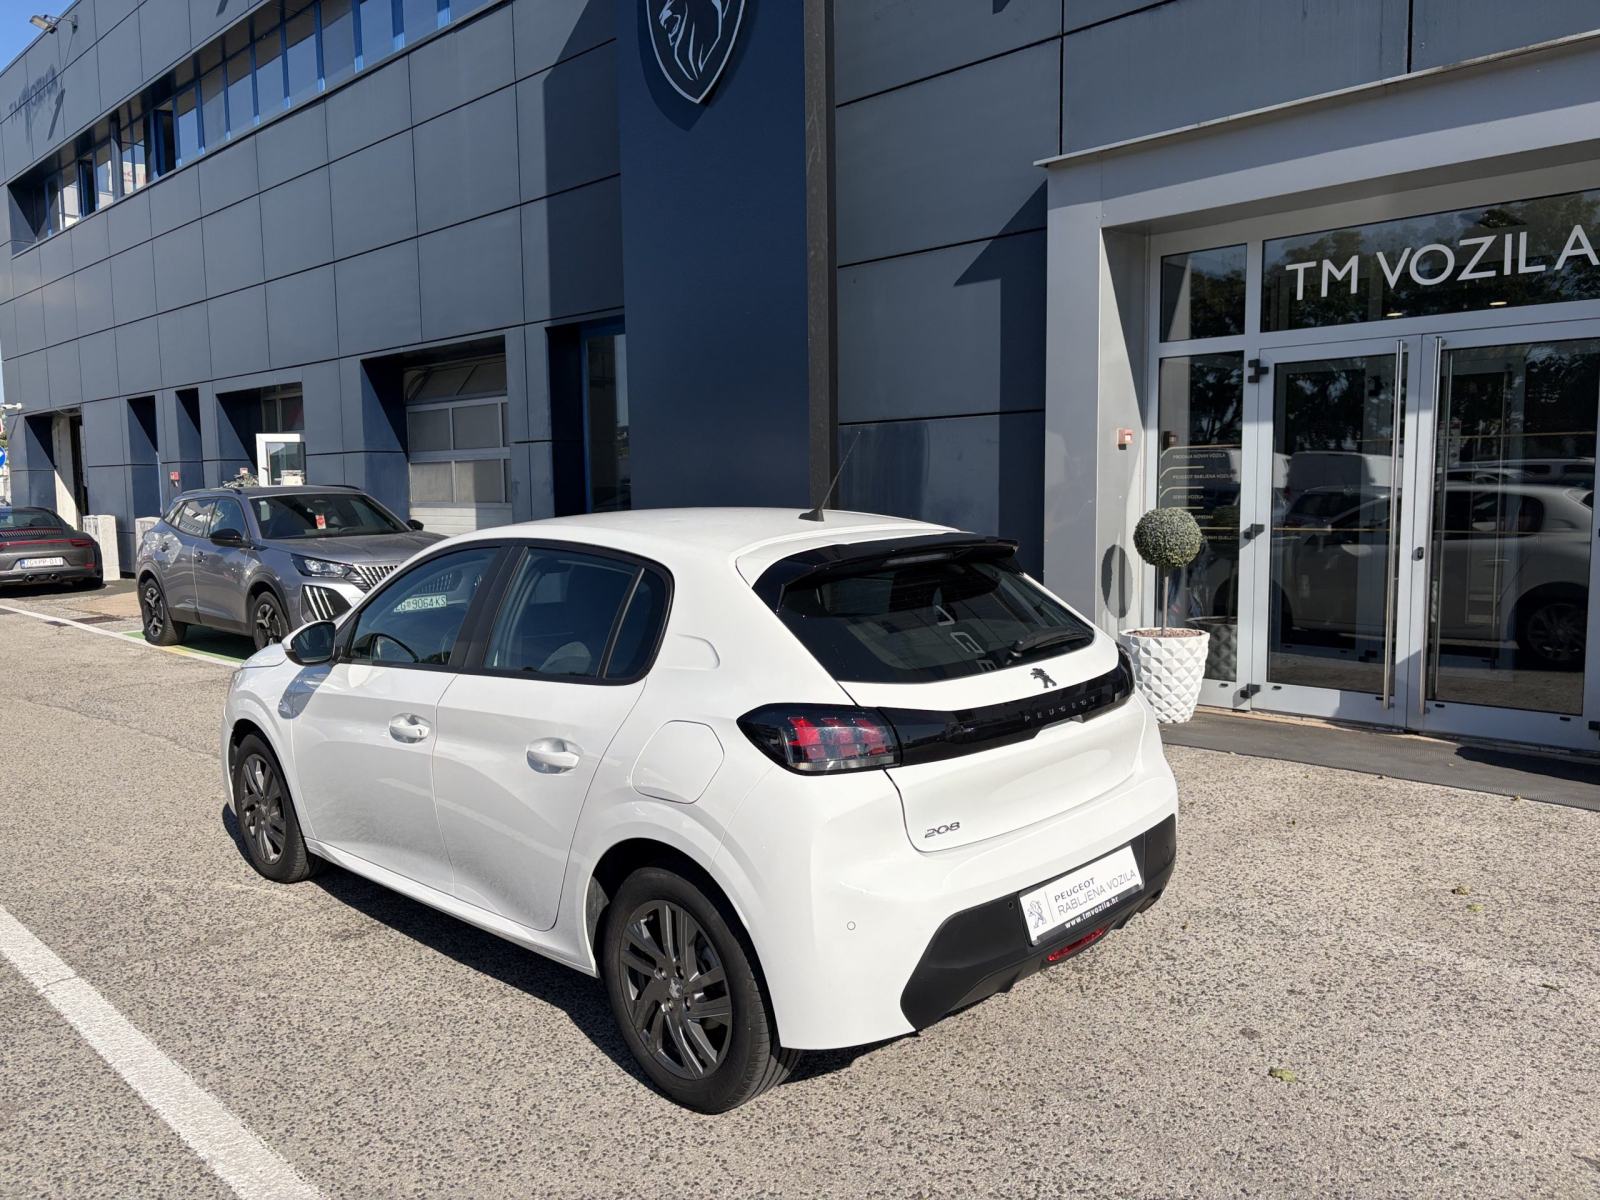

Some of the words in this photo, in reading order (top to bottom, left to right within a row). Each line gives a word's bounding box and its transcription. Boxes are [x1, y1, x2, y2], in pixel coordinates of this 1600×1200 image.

[1285, 255, 1360, 301] TM
[1376, 224, 1600, 290] VOZILA
[1024, 695, 1096, 722] PEUGEOT
[925, 821, 960, 838] 208
[1054, 877, 1096, 903] PEUGEOT
[1057, 885, 1107, 916] RABLJENA
[1106, 869, 1137, 891] VOZILA
[1064, 896, 1119, 929] www.tmvozila.hr
